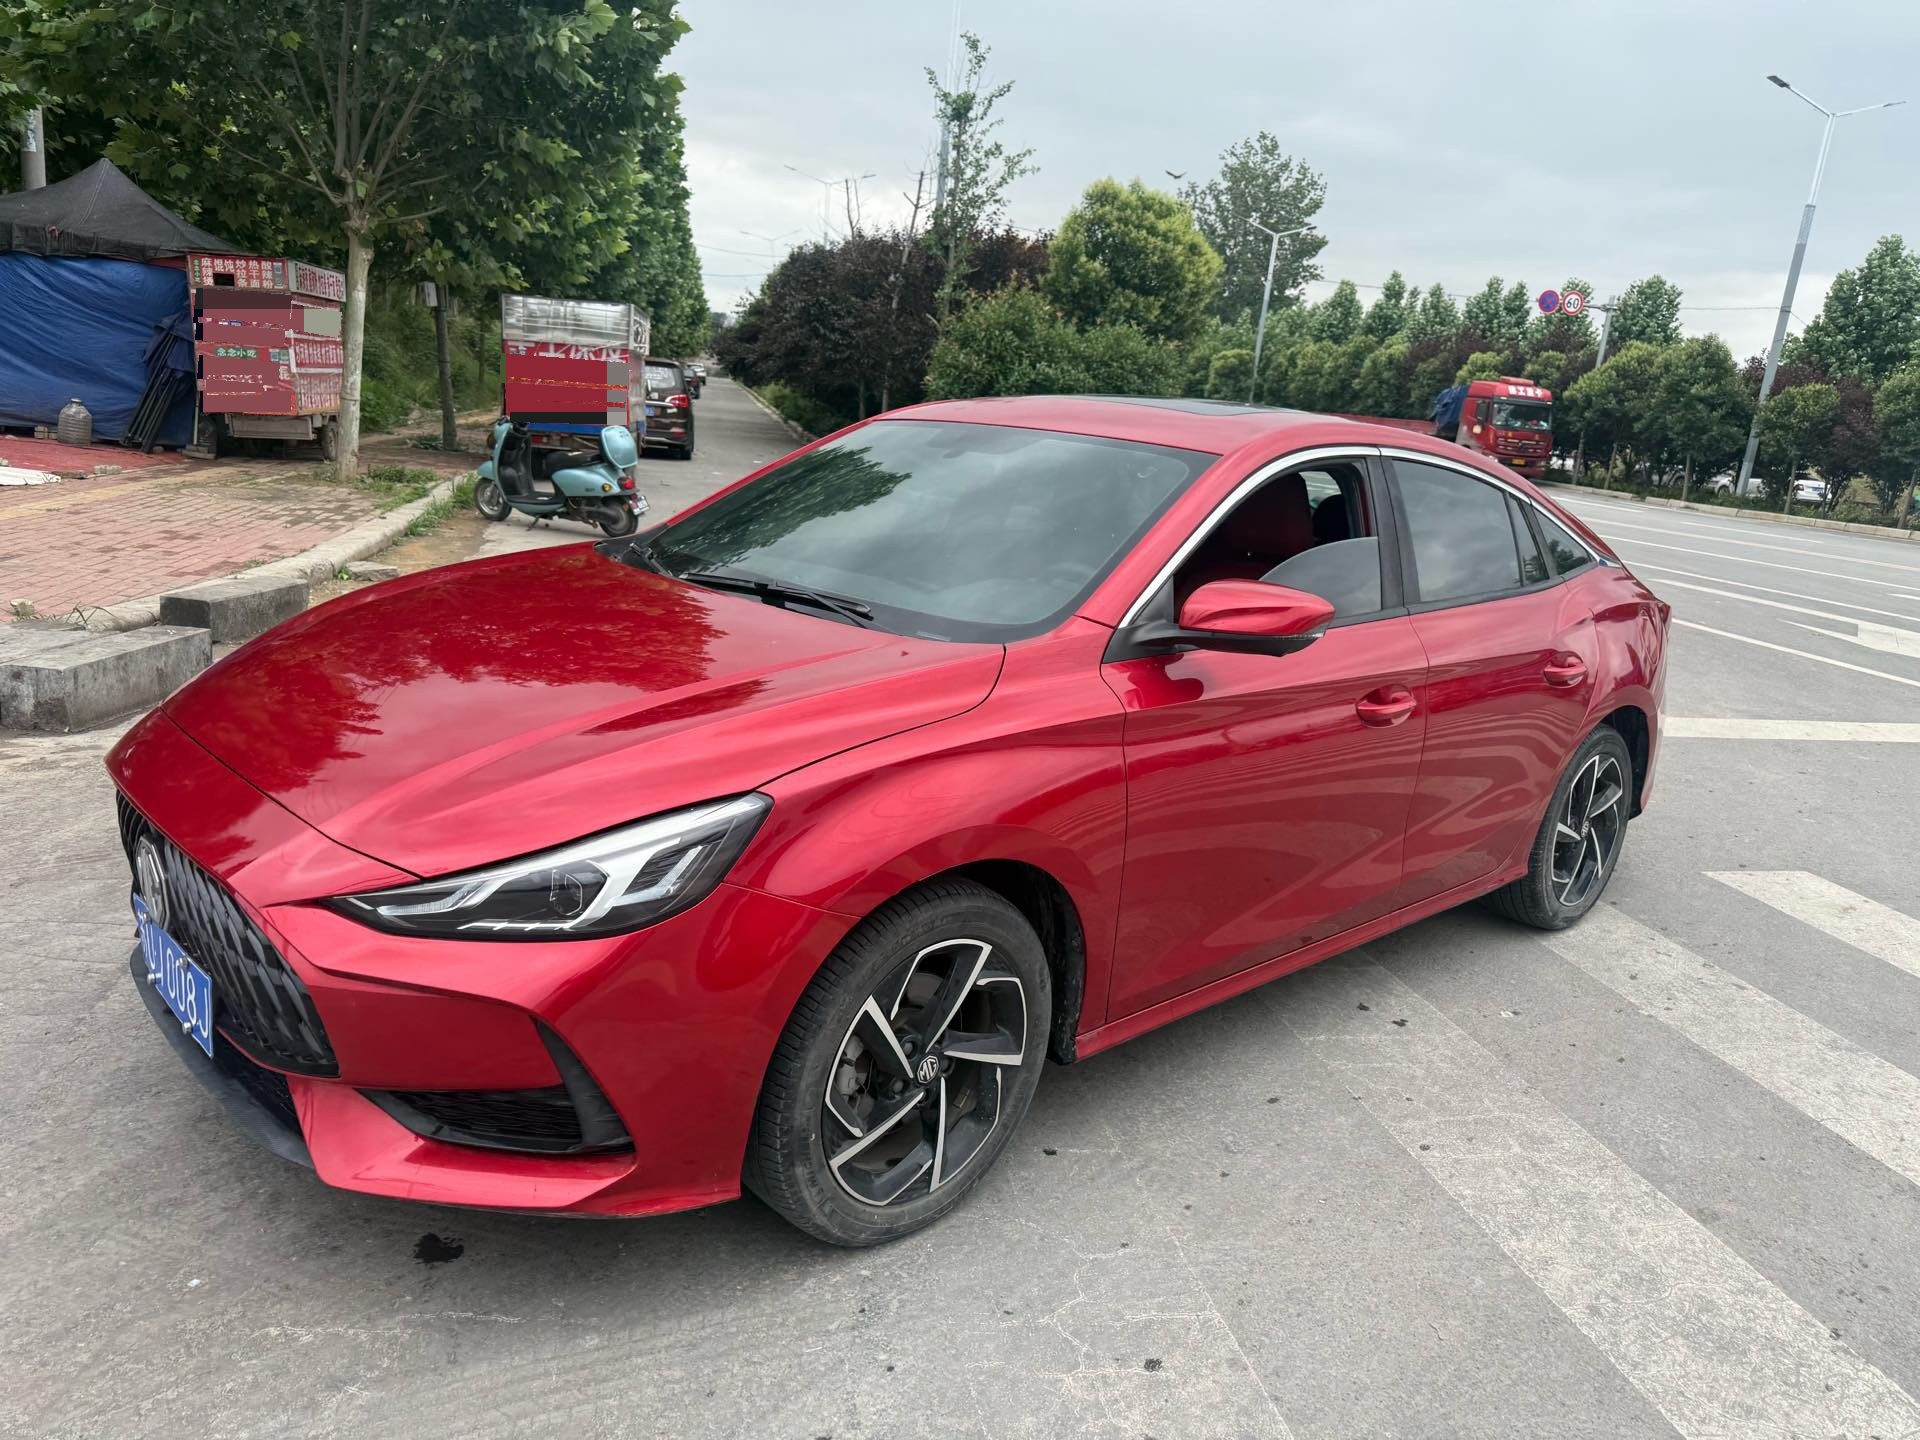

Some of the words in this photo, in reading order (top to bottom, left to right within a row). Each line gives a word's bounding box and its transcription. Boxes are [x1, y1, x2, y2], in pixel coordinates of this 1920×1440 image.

[248, 260, 260, 288] 热干面
[261, 260, 273, 289] 酸辣粉
[1566, 297, 1580, 309] 60
[216, 347, 257, 358] 念念小吃
[919, 1058, 937, 1081] MG
